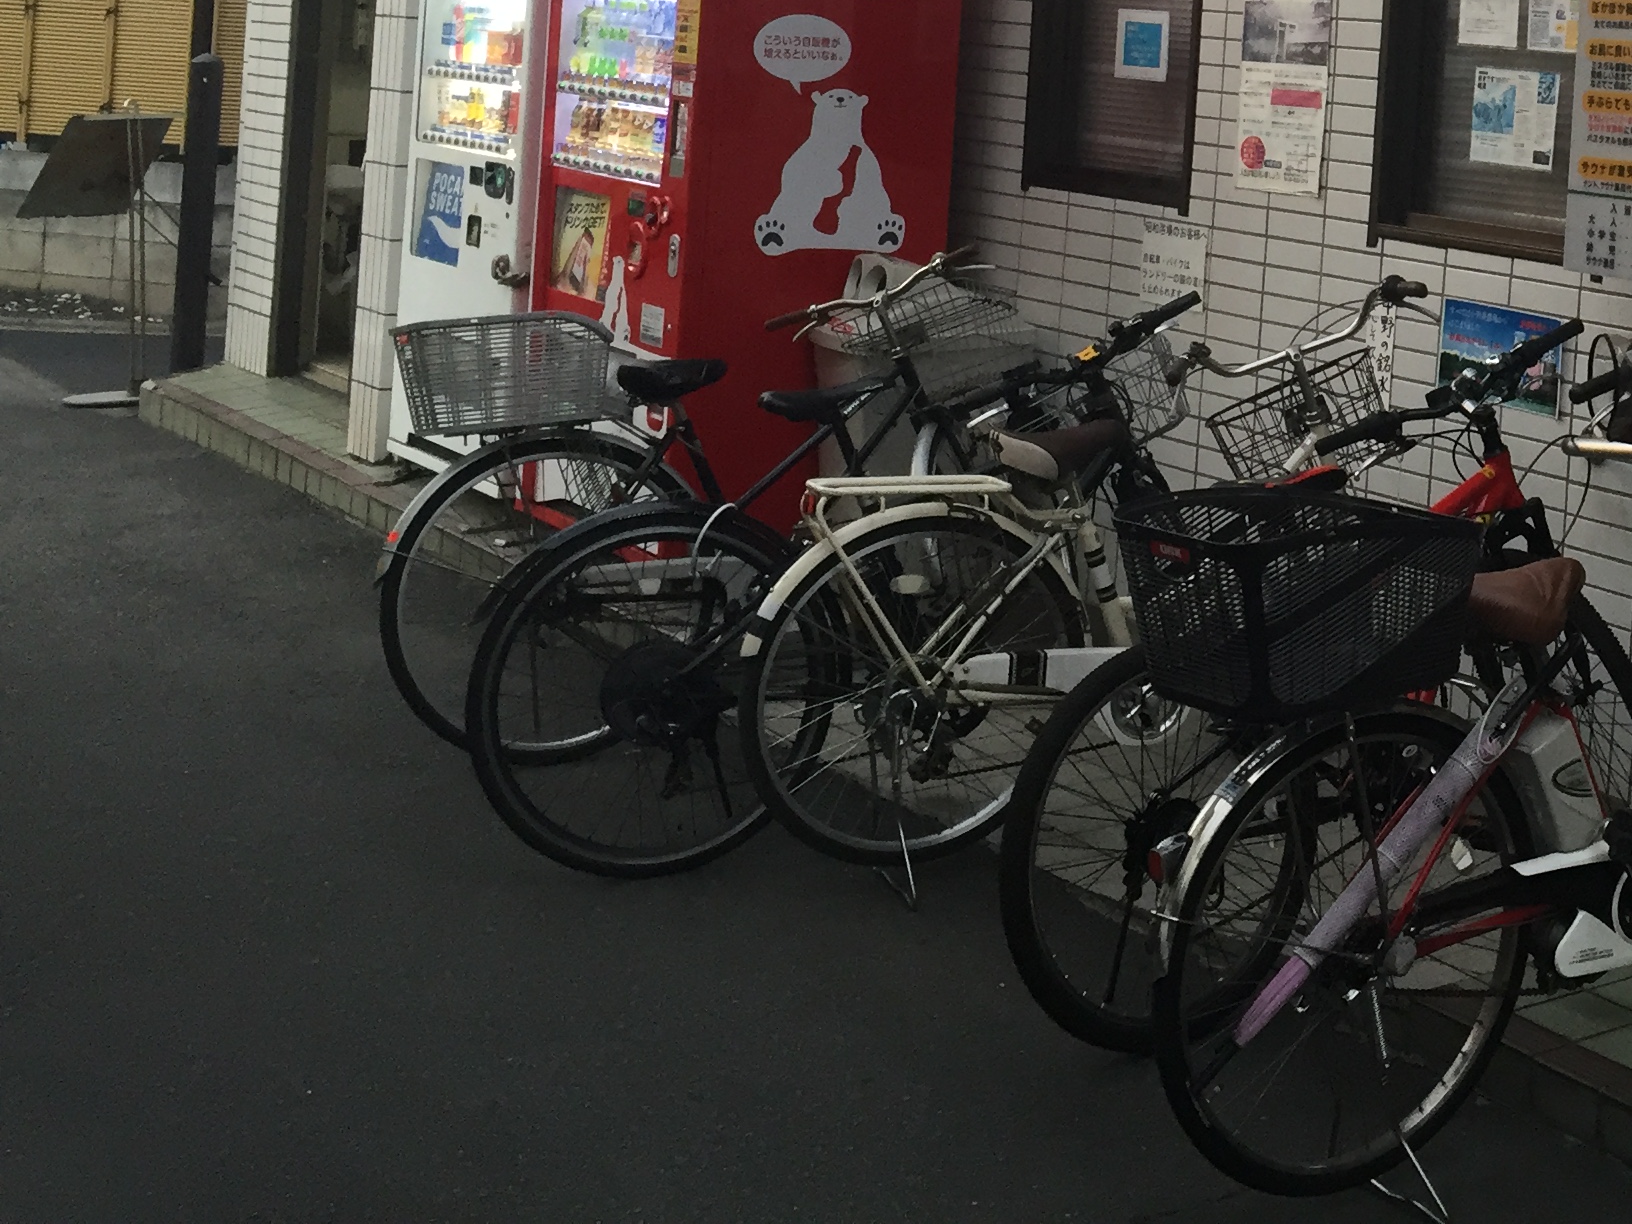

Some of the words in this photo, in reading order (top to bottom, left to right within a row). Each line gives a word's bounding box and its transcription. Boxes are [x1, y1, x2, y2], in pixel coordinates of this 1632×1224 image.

[764, 35, 841, 49] こういう自販機が
[433, 172, 465, 197] POCA
